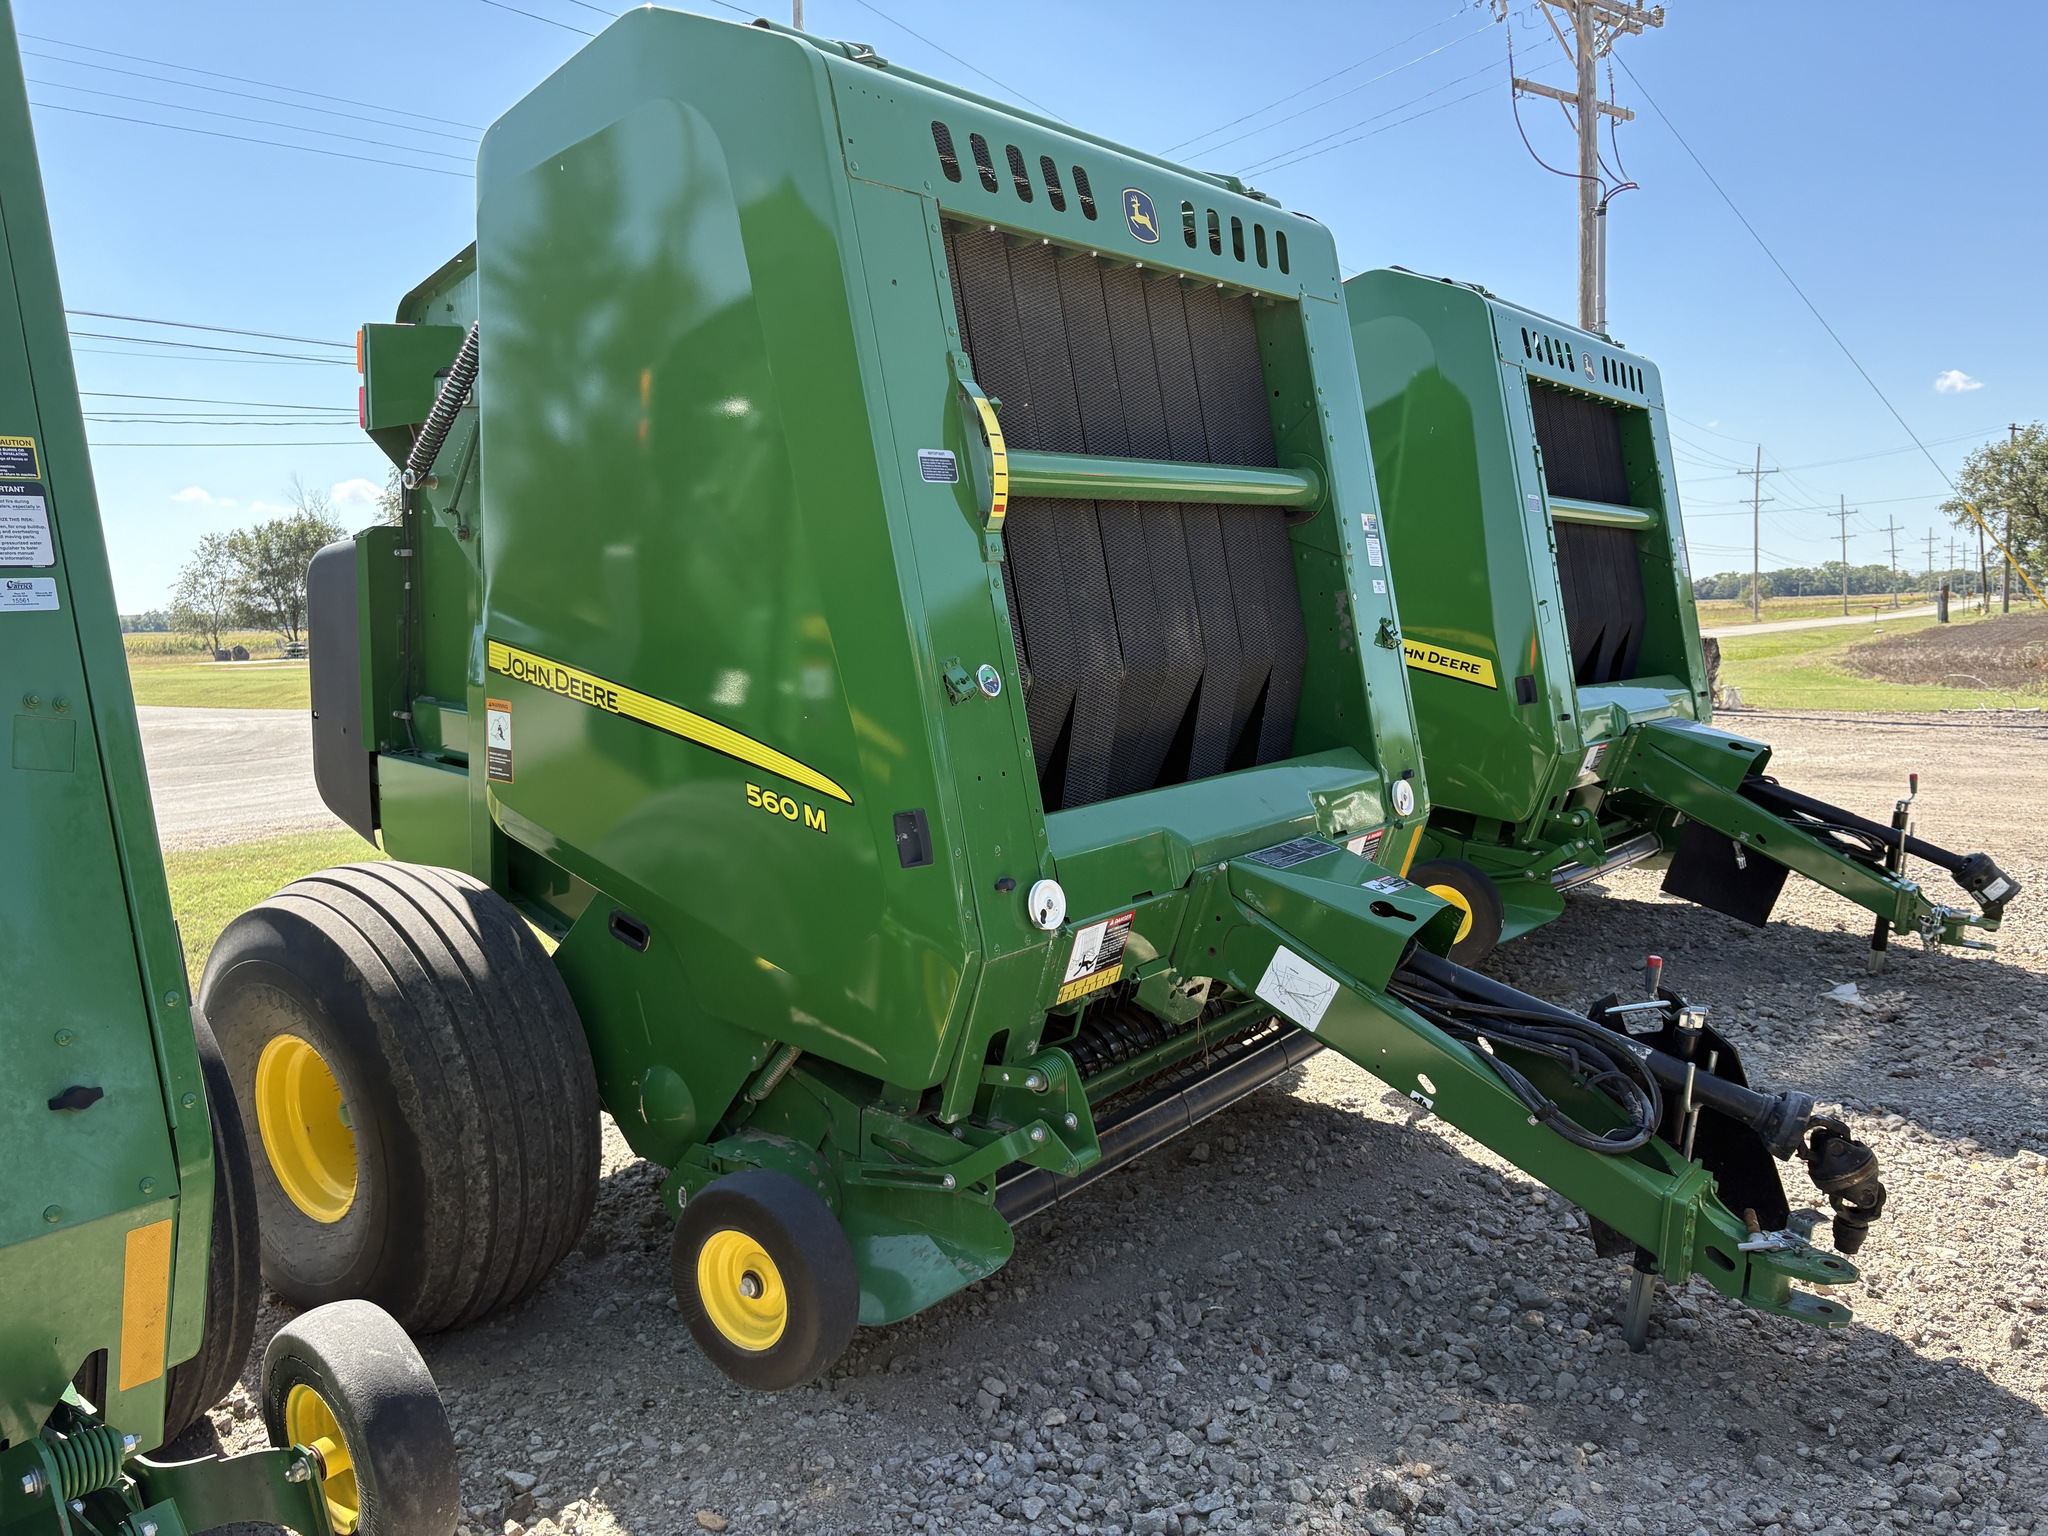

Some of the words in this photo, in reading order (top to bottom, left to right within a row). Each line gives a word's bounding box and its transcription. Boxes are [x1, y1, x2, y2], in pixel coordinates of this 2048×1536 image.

[502, 652, 551, 687] JOHN
[555, 667, 619, 711] DEERE
[1404, 647, 1425, 661] HN
[1428, 651, 1481, 675] DEERE
[745, 781, 800, 822] 560
[803, 802, 828, 834] M
